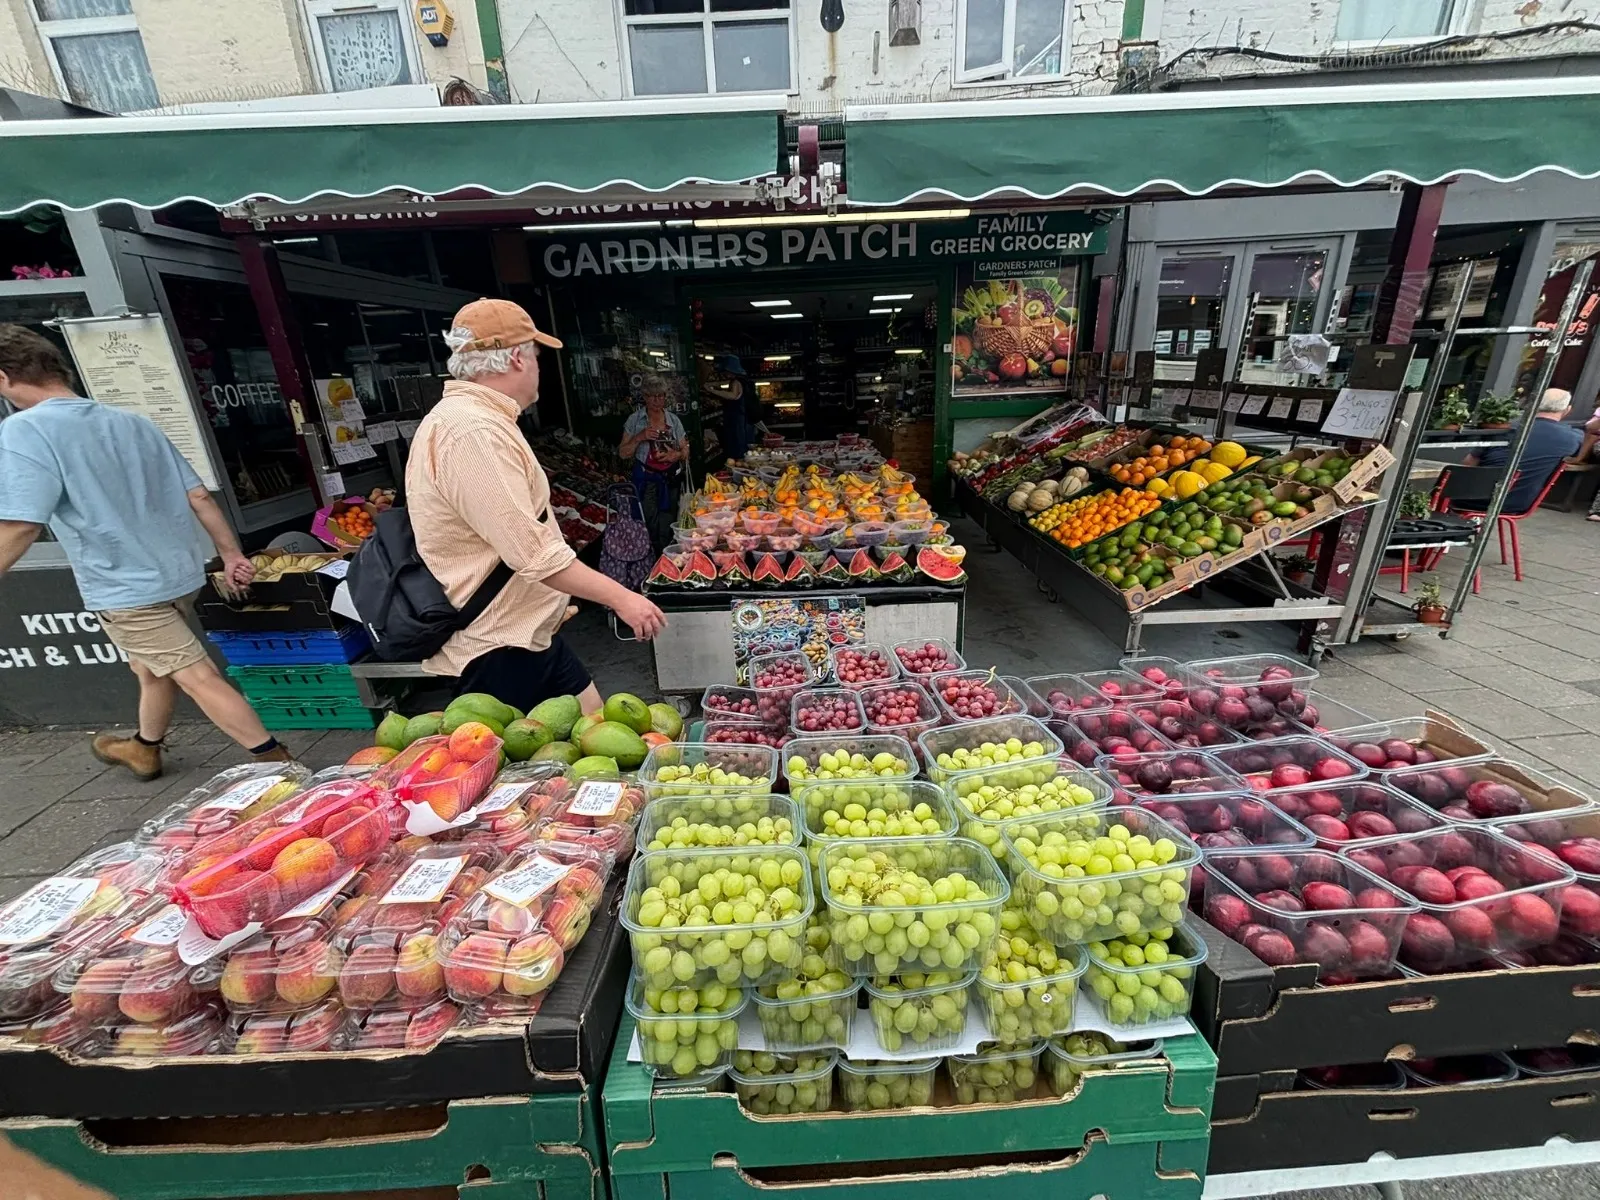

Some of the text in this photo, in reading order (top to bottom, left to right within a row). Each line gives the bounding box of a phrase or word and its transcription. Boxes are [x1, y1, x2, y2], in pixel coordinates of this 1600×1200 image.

[423, 10, 437, 20] ADT
[977, 215, 1048, 234] FAMILY
[544, 223, 917, 278] GARDNERS PATCH
[930, 232, 1094, 255] GREEN GROCERY
[978, 259, 1056, 271] GARDNERS PATCH
[211, 383, 280, 408] COFFEE
[43, 645, 70, 667] &
